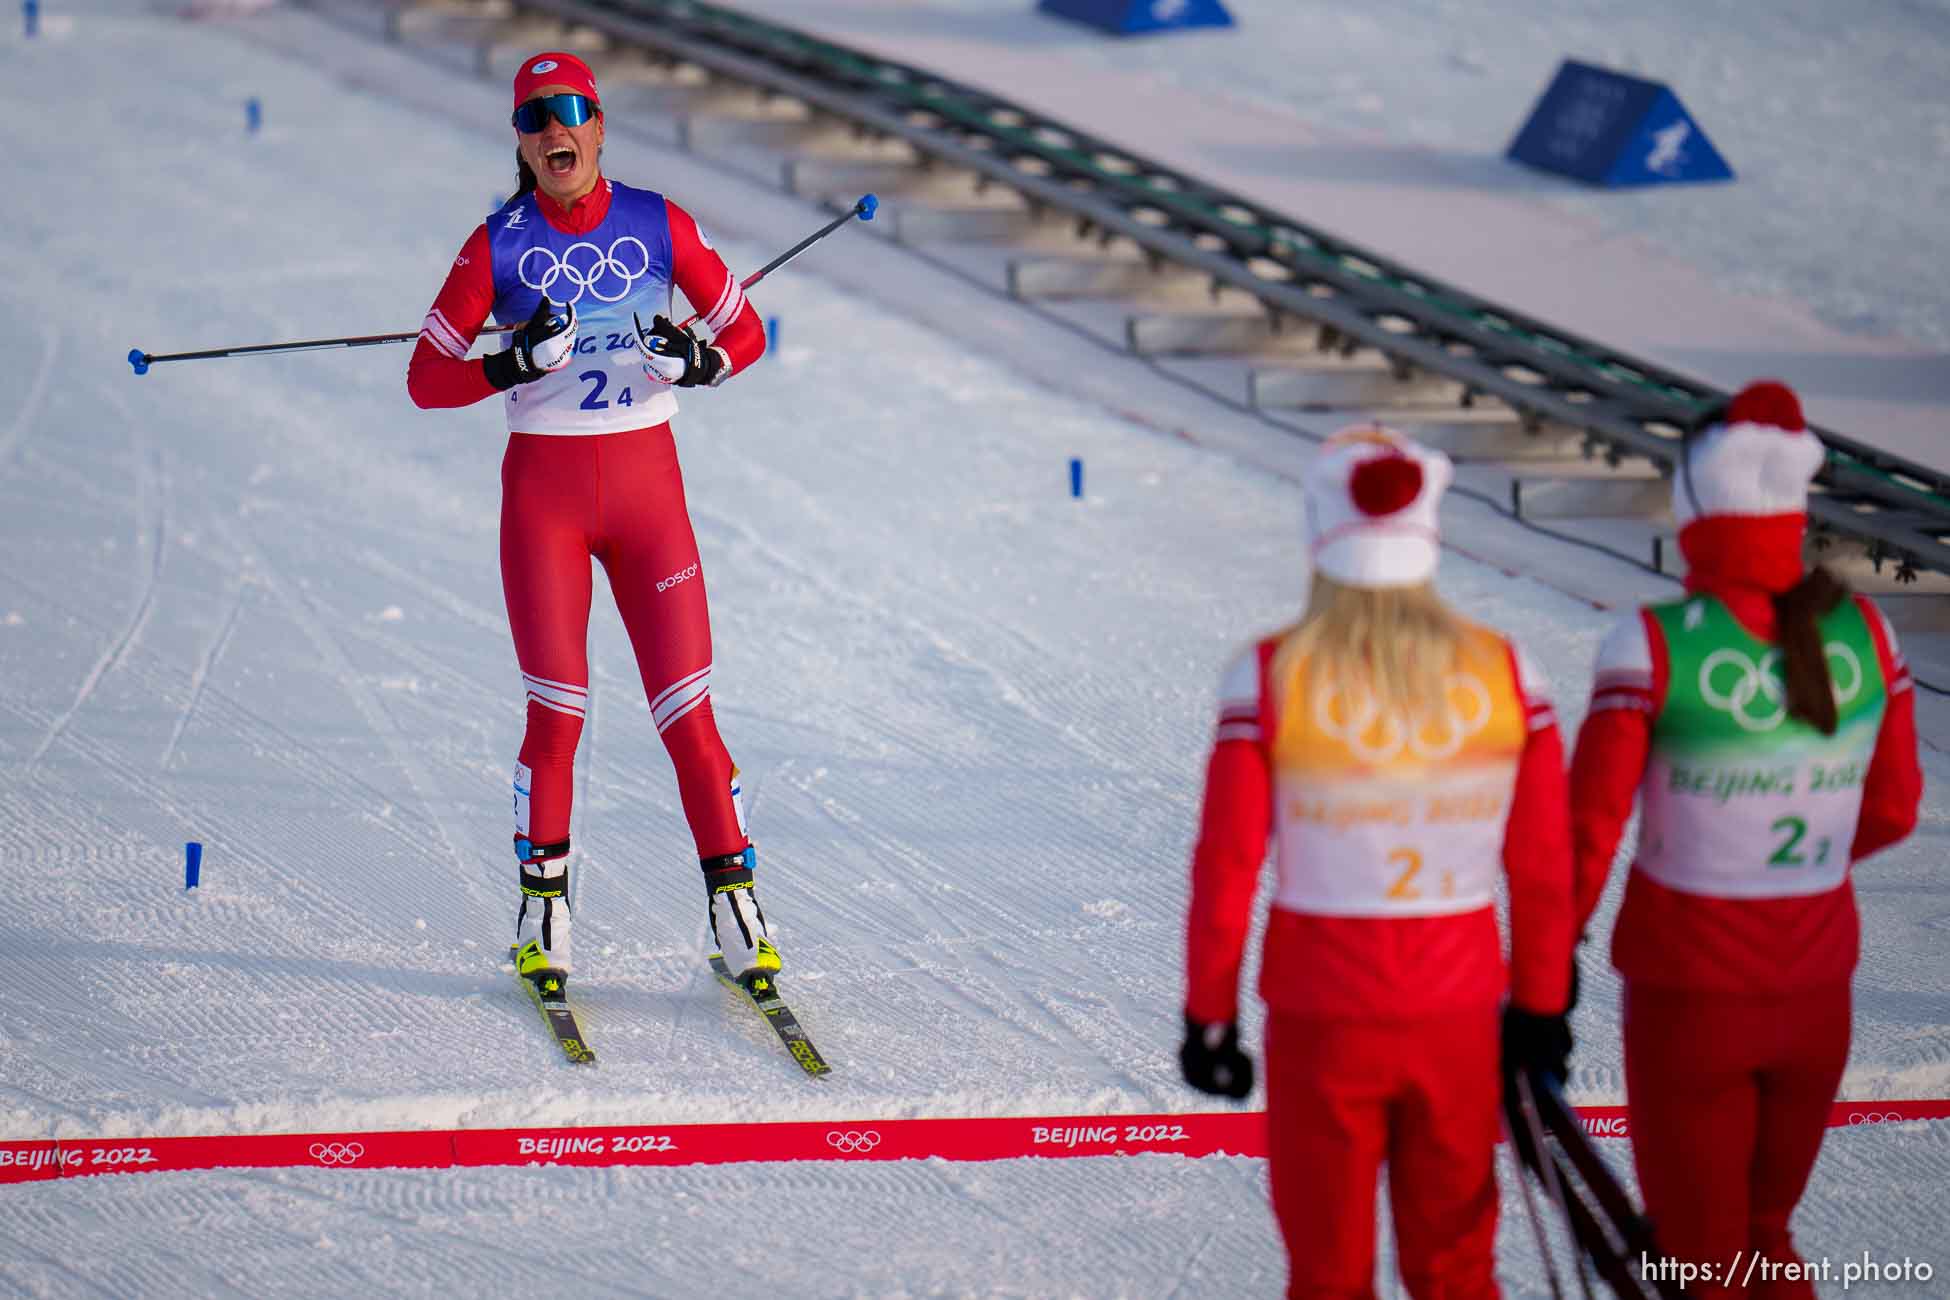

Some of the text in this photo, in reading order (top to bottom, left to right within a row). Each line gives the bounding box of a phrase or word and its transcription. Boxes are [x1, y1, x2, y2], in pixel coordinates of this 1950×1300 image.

[514, 345, 529, 372] SWIX
[511, 391, 518, 402] 4
[578, 370, 633, 410] 2 4
[1767, 815, 1807, 866] 2
[1384, 848, 1424, 899] 2
[715, 881, 754, 894] FISCHE
[518, 1136, 678, 1158] BEIJING 2022
[1032, 1125, 1190, 1148] BEIJING 2022
[0, 1148, 158, 1170] BEIJING 2022
